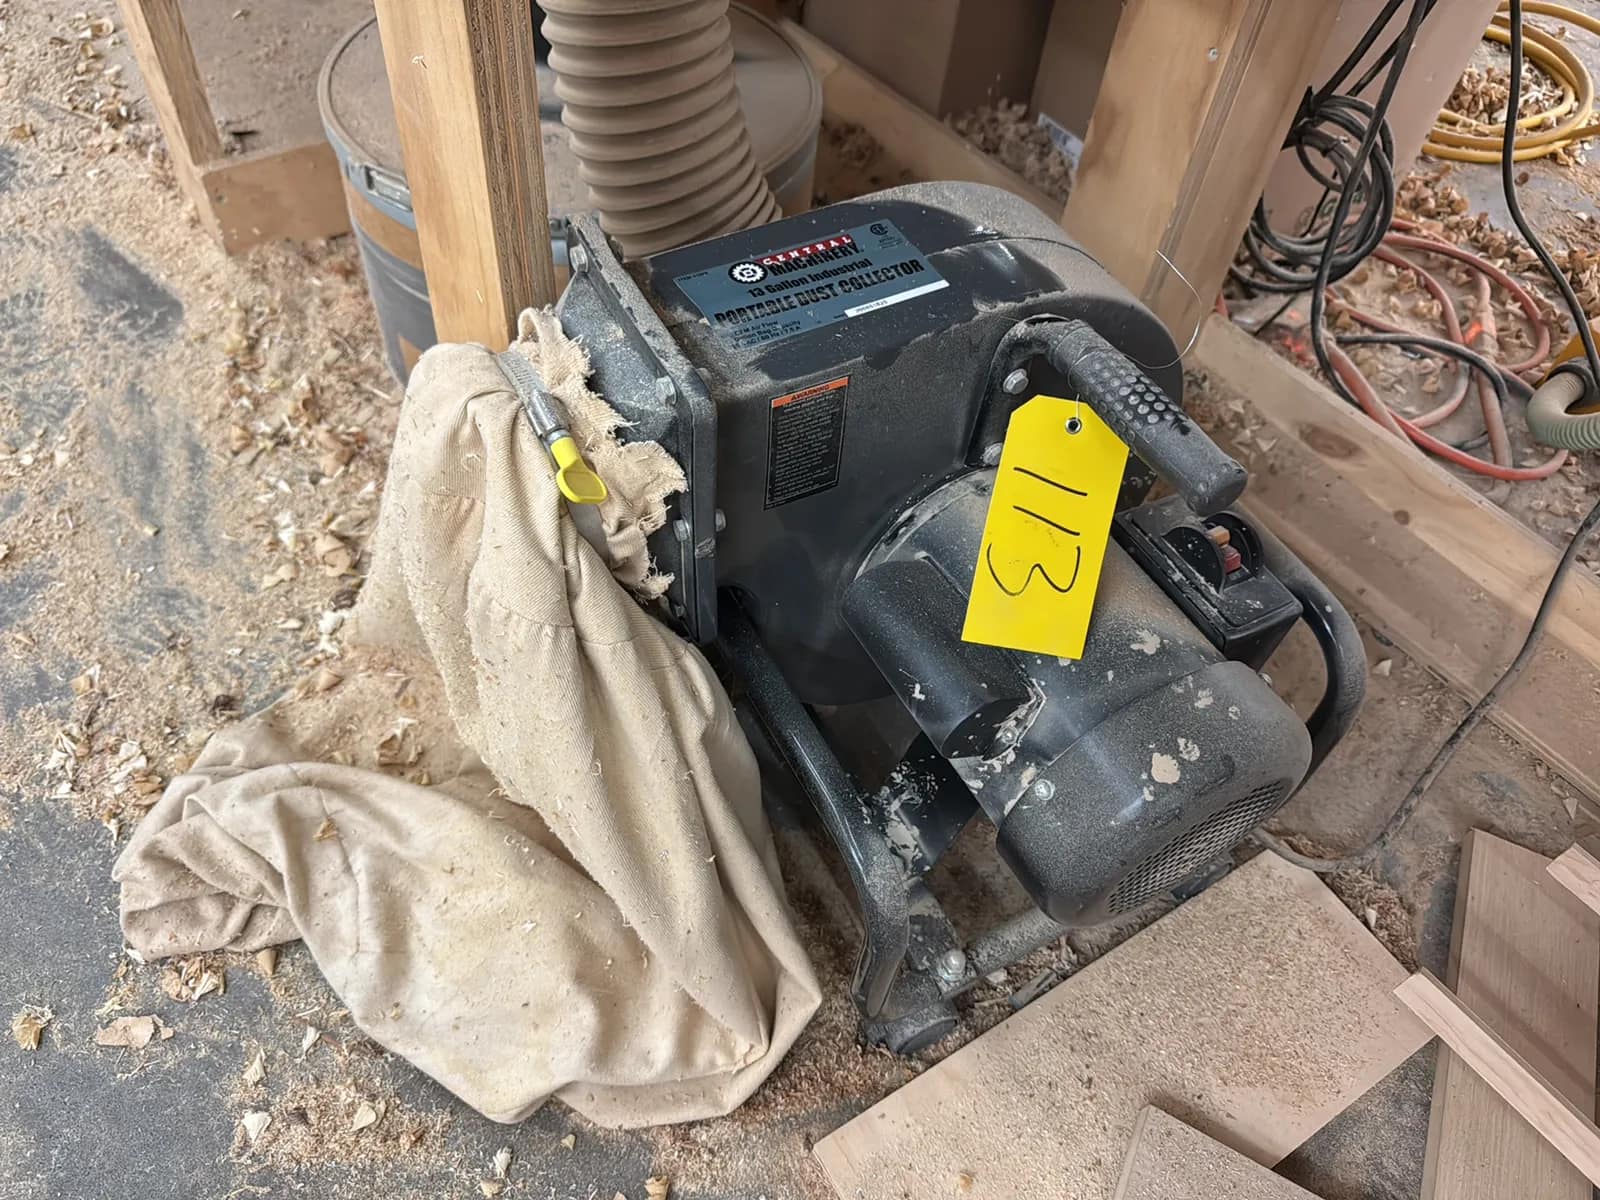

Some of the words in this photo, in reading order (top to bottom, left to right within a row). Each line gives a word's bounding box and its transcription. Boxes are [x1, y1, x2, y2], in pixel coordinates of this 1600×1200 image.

[762, 235, 852, 265] CENTRAL
[713, 295, 801, 327] PORTABLE
[795, 283, 839, 307] DUST
[838, 258, 925, 294] COLLECTOR
[748, 288, 765, 298] 13
[765, 276, 809, 294] Gallon
[807, 258, 873, 284] Industrial
